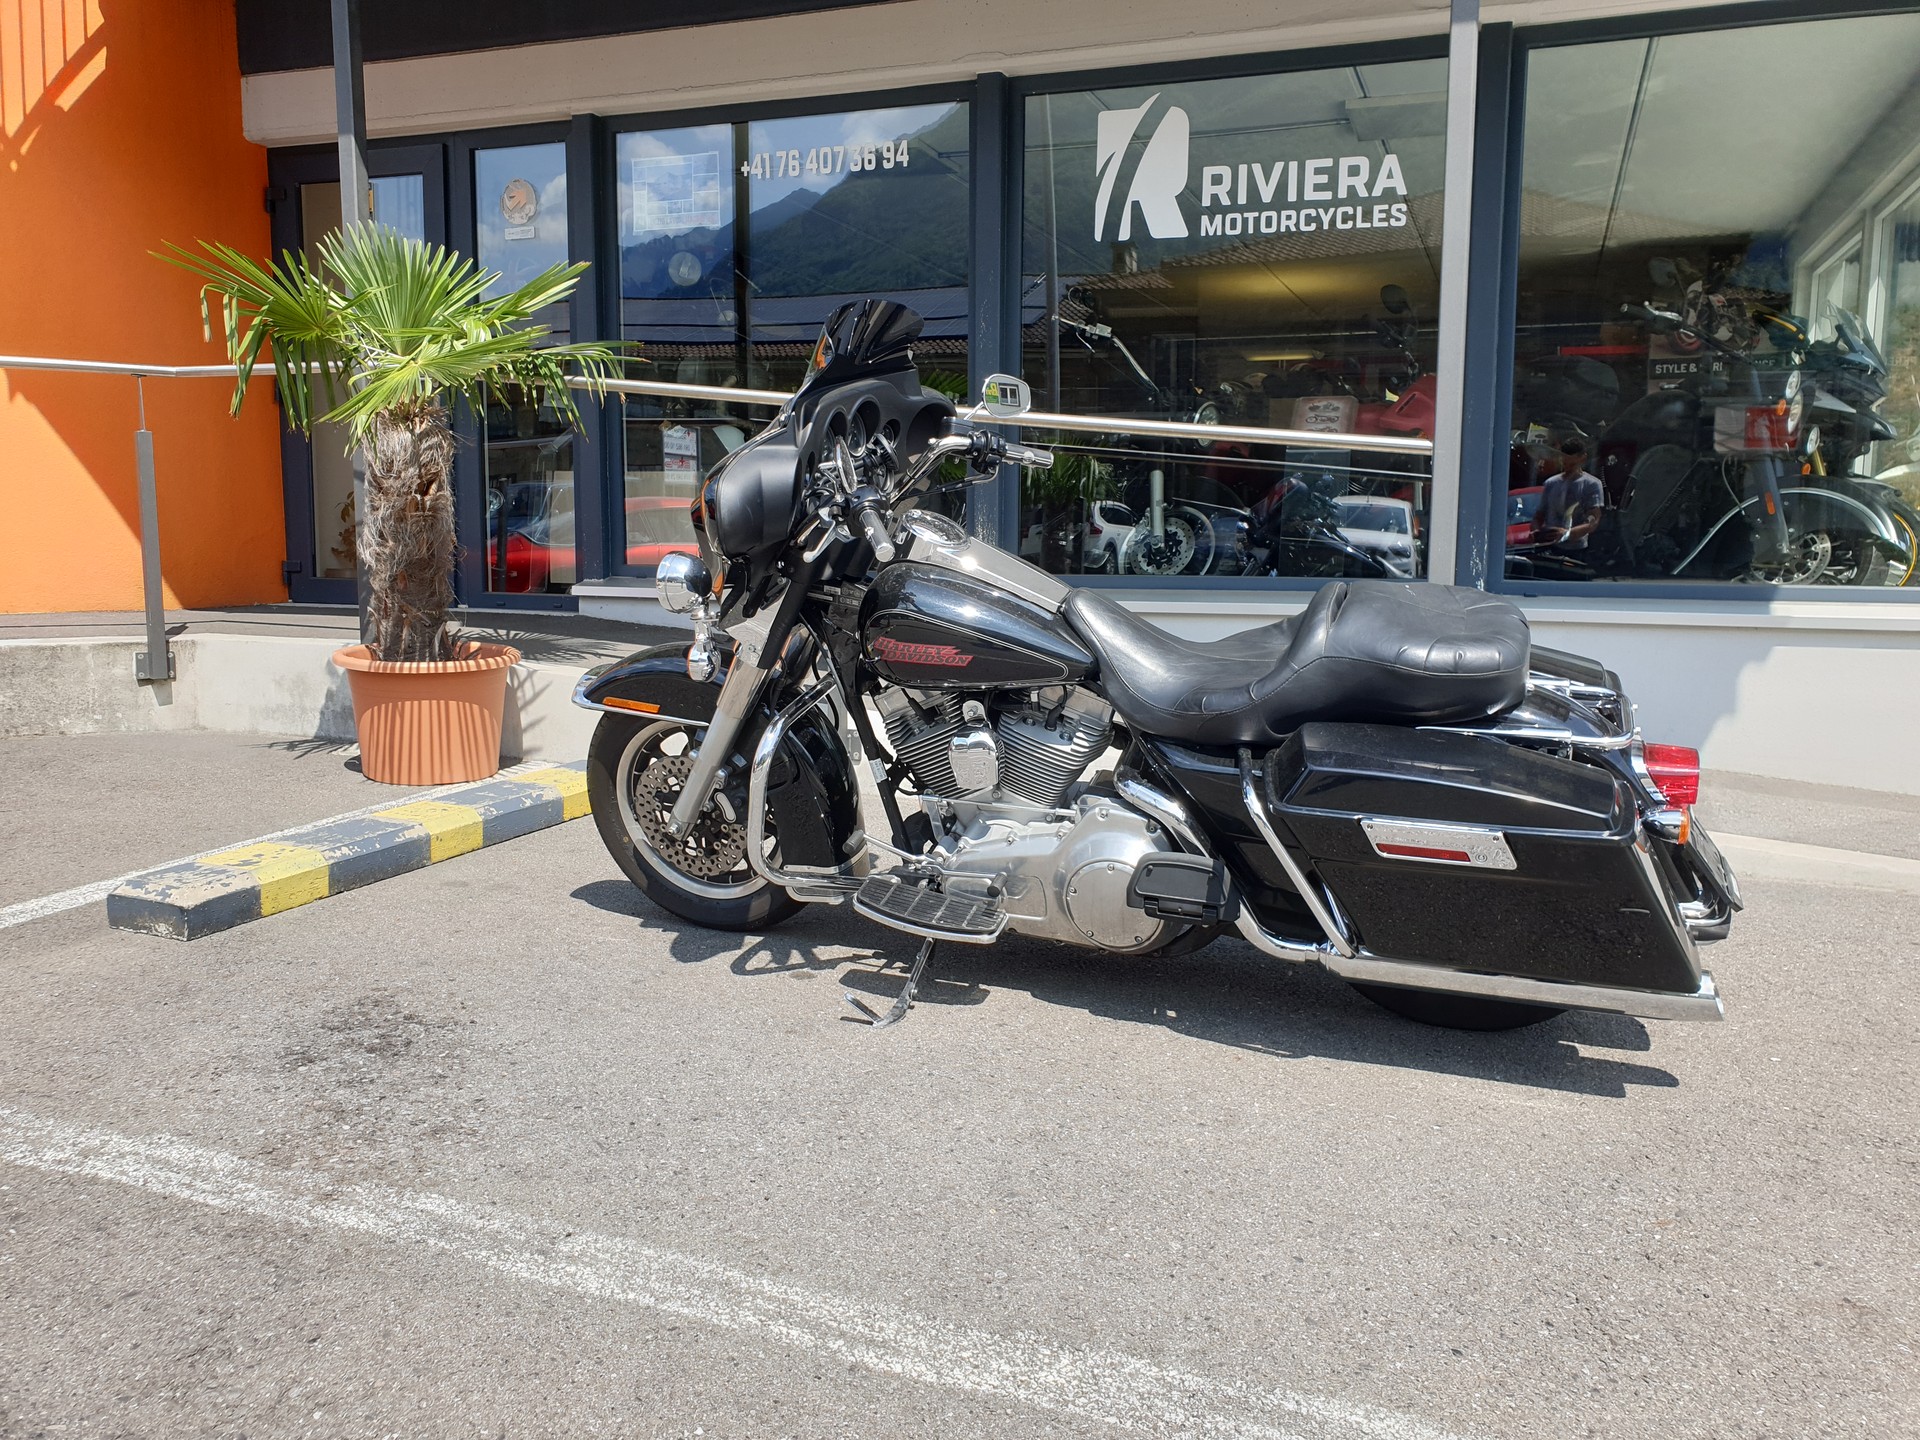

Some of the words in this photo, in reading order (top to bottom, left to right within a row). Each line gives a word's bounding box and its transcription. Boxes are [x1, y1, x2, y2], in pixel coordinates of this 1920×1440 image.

[741, 152, 771, 180] +41
[775, 149, 801, 178] 76
[805, 145, 845, 175] 407
[850, 143, 877, 173] 36
[881, 139, 910, 169] 94
[1202, 153, 1408, 207] RIVIERA
[1200, 204, 1408, 237] MOTORCYCLES
[1655, 363, 1688, 375] STYLE
[882, 650, 973, 667] DAVIDSON
